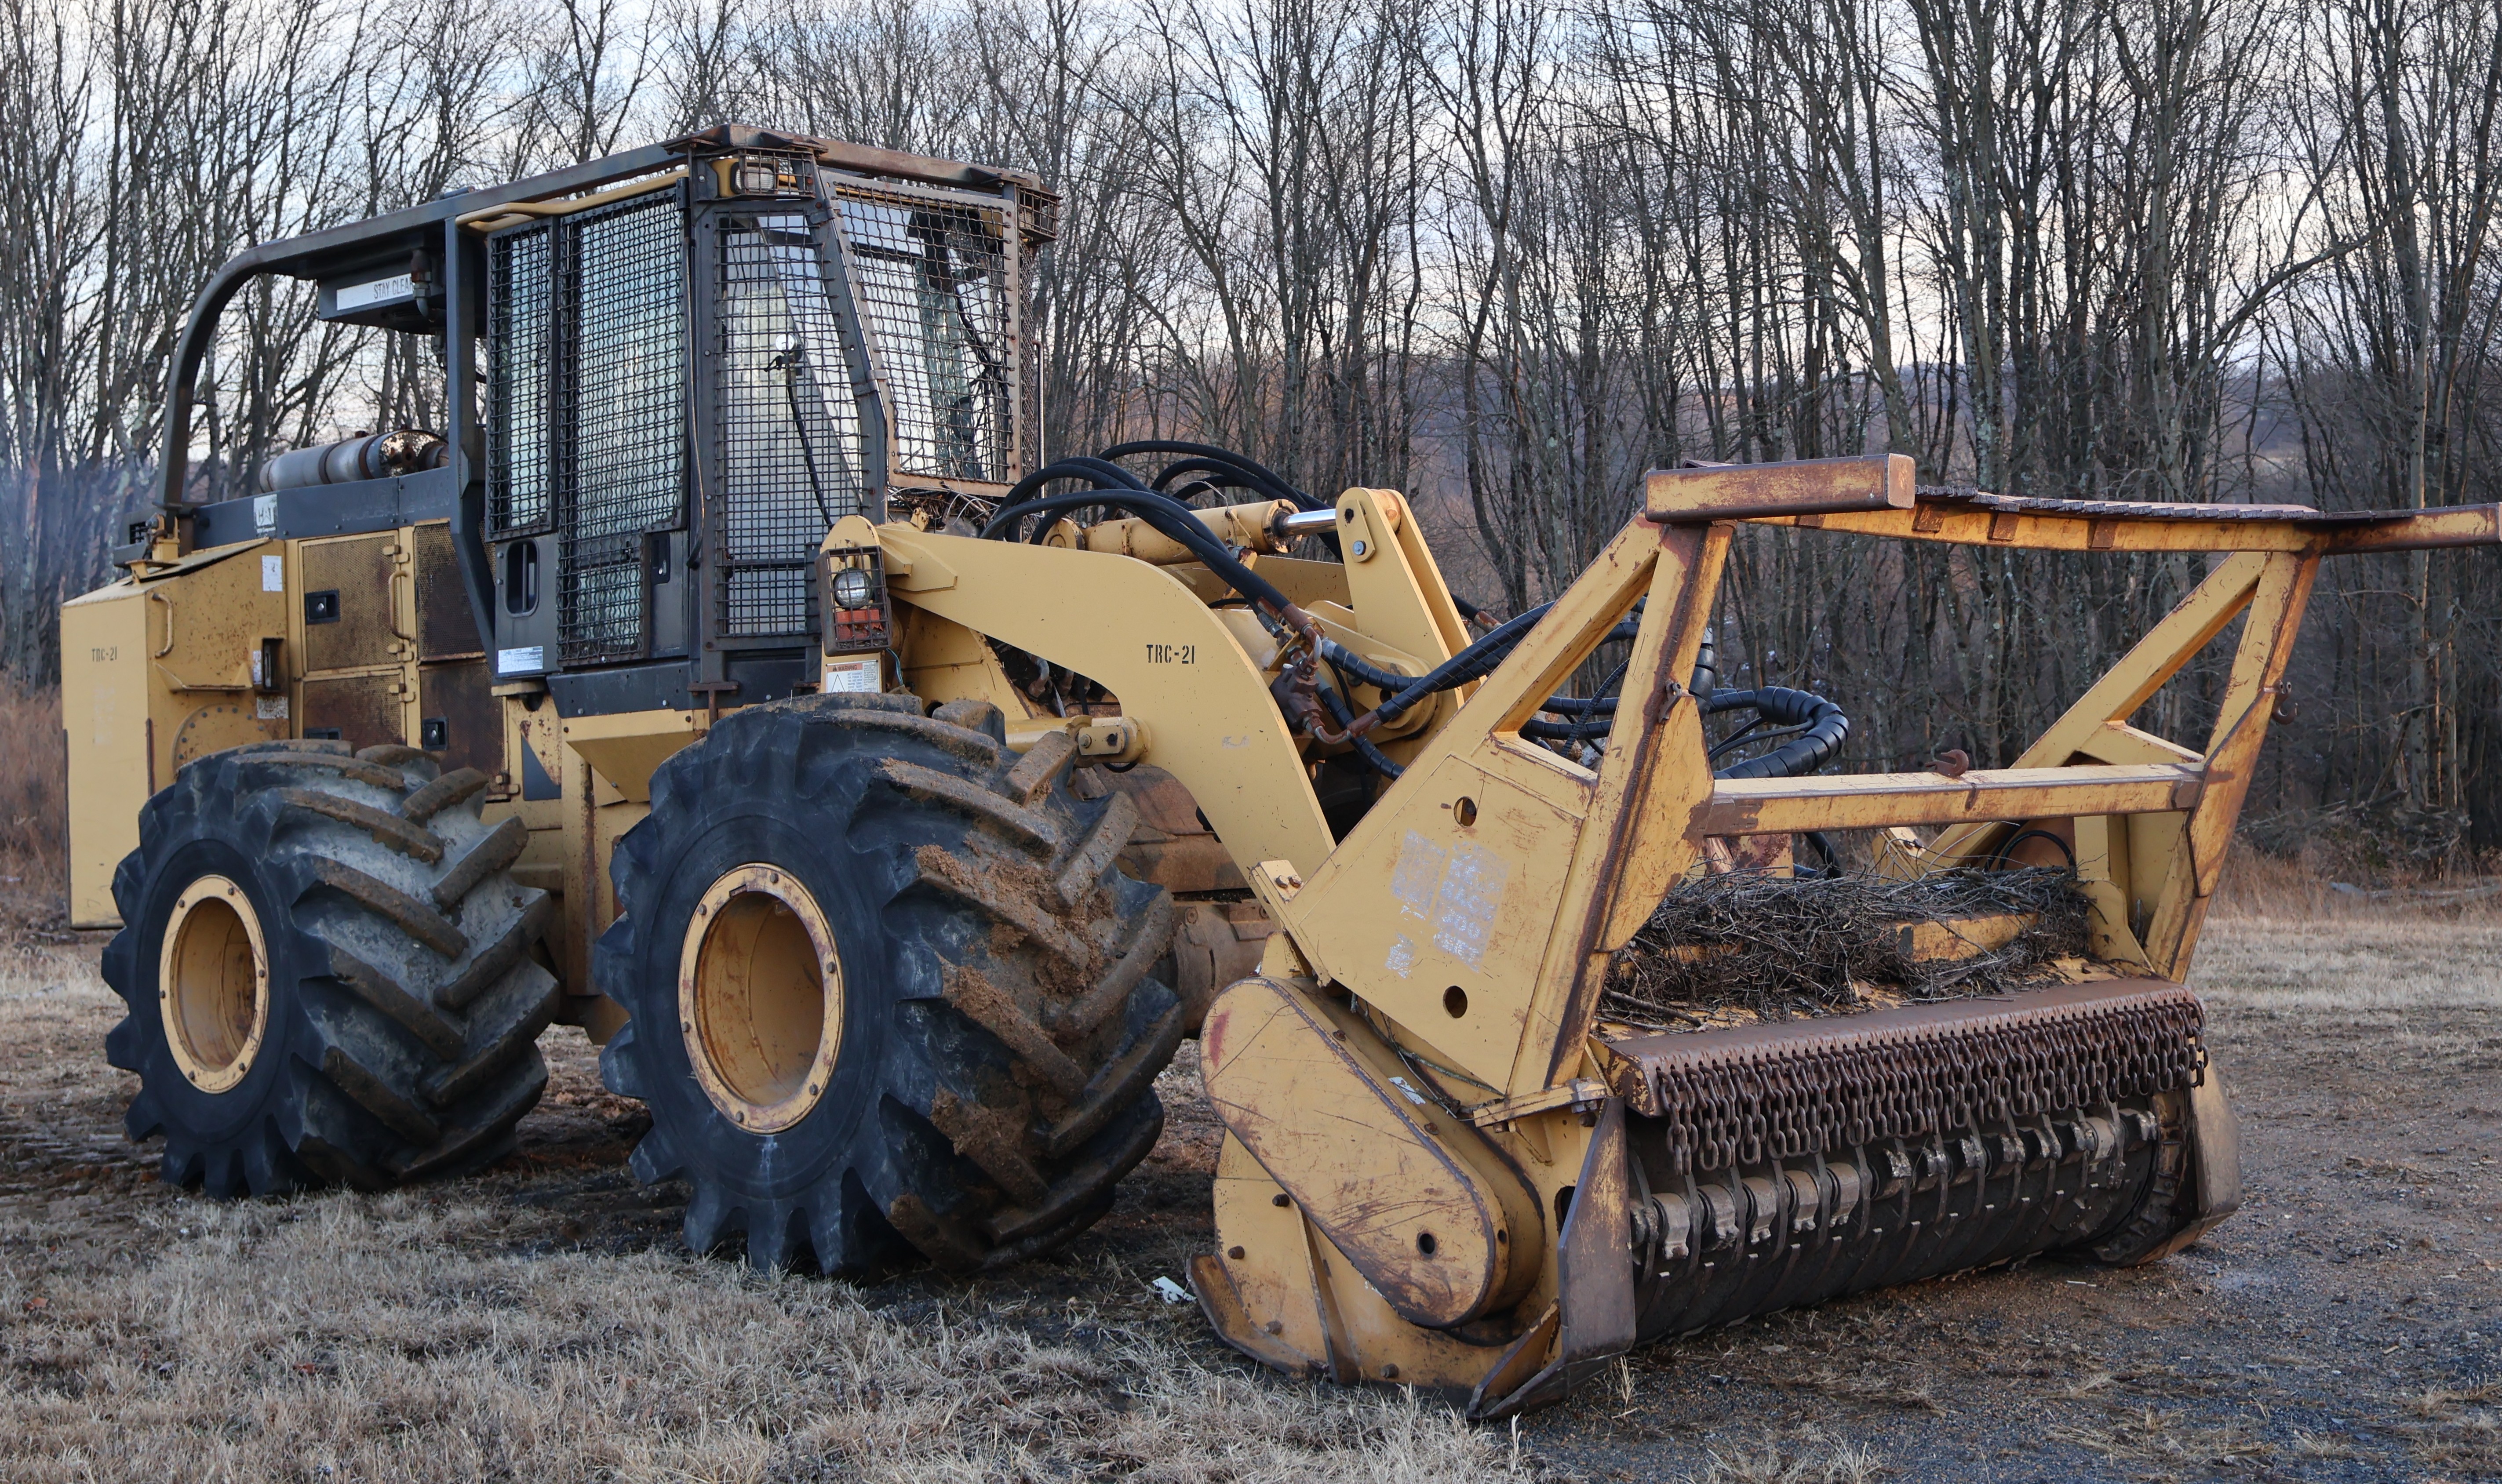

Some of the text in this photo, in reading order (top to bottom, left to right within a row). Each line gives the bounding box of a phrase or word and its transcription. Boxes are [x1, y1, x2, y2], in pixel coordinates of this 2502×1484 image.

[374, 282, 390, 299] STAY
[91, 646, 117, 662] TRC-21
[1146, 644, 1195, 664] TRC-21
